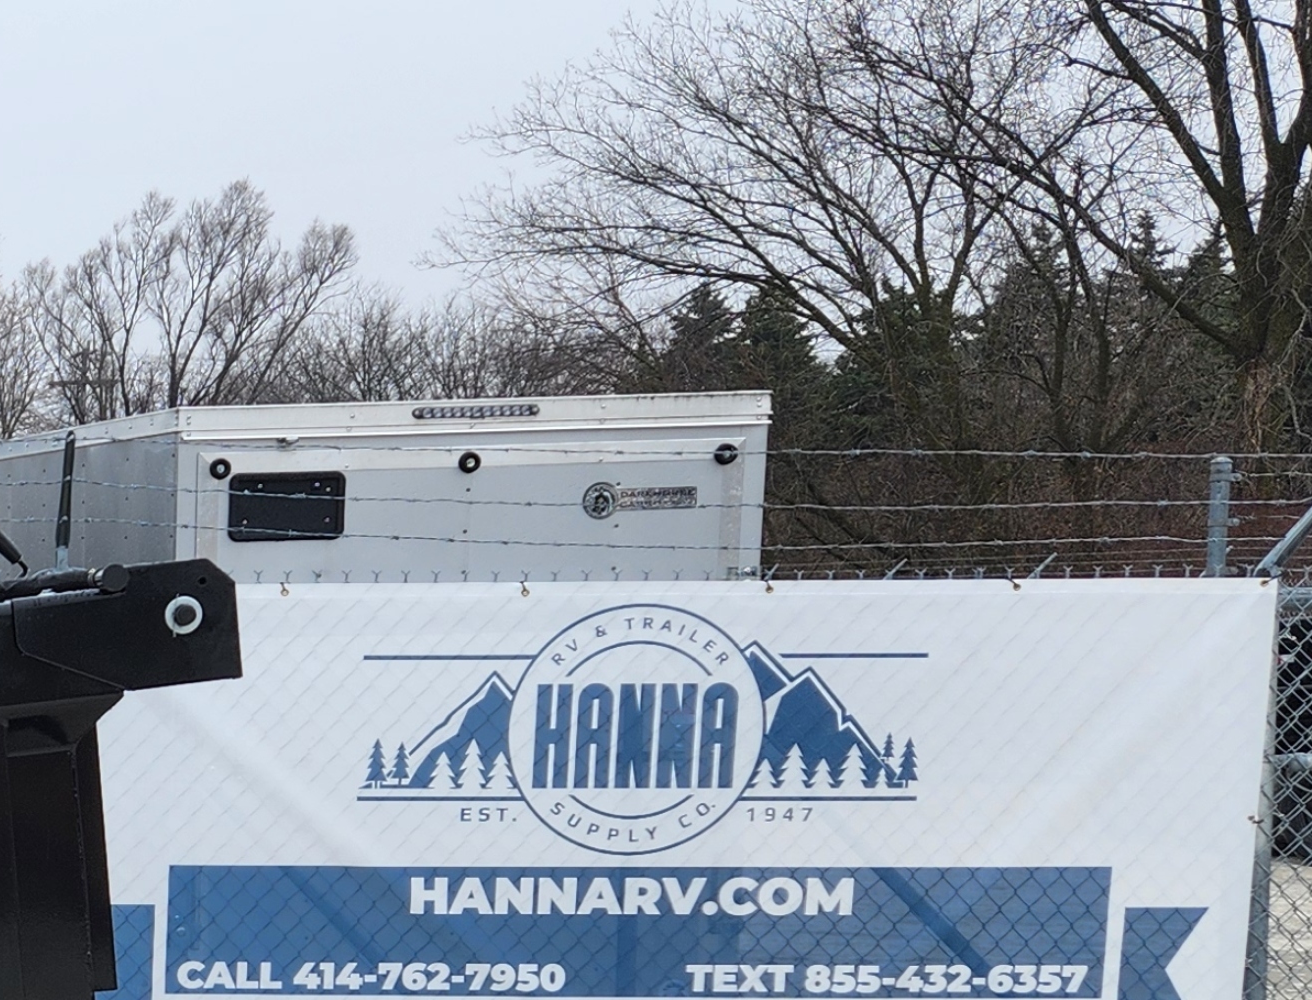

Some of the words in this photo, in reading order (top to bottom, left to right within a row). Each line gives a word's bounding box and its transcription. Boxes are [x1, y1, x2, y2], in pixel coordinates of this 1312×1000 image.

[550, 638, 579, 667] RV
[594, 624, 608, 639] &
[623, 617, 730, 666] TRAILER
[531, 682, 740, 789] HANNA
[459, 807, 518, 823] EST.
[549, 801, 659, 843] SUPPLY
[746, 806, 814, 823] 1947
[409, 876, 855, 916] HANNARV.COM
[176, 960, 283, 990] CALL
[292, 961, 567, 993] 414-762-7950
[685, 963, 796, 993] TEXT
[803, 963, 1090, 994] 855-432-6357
